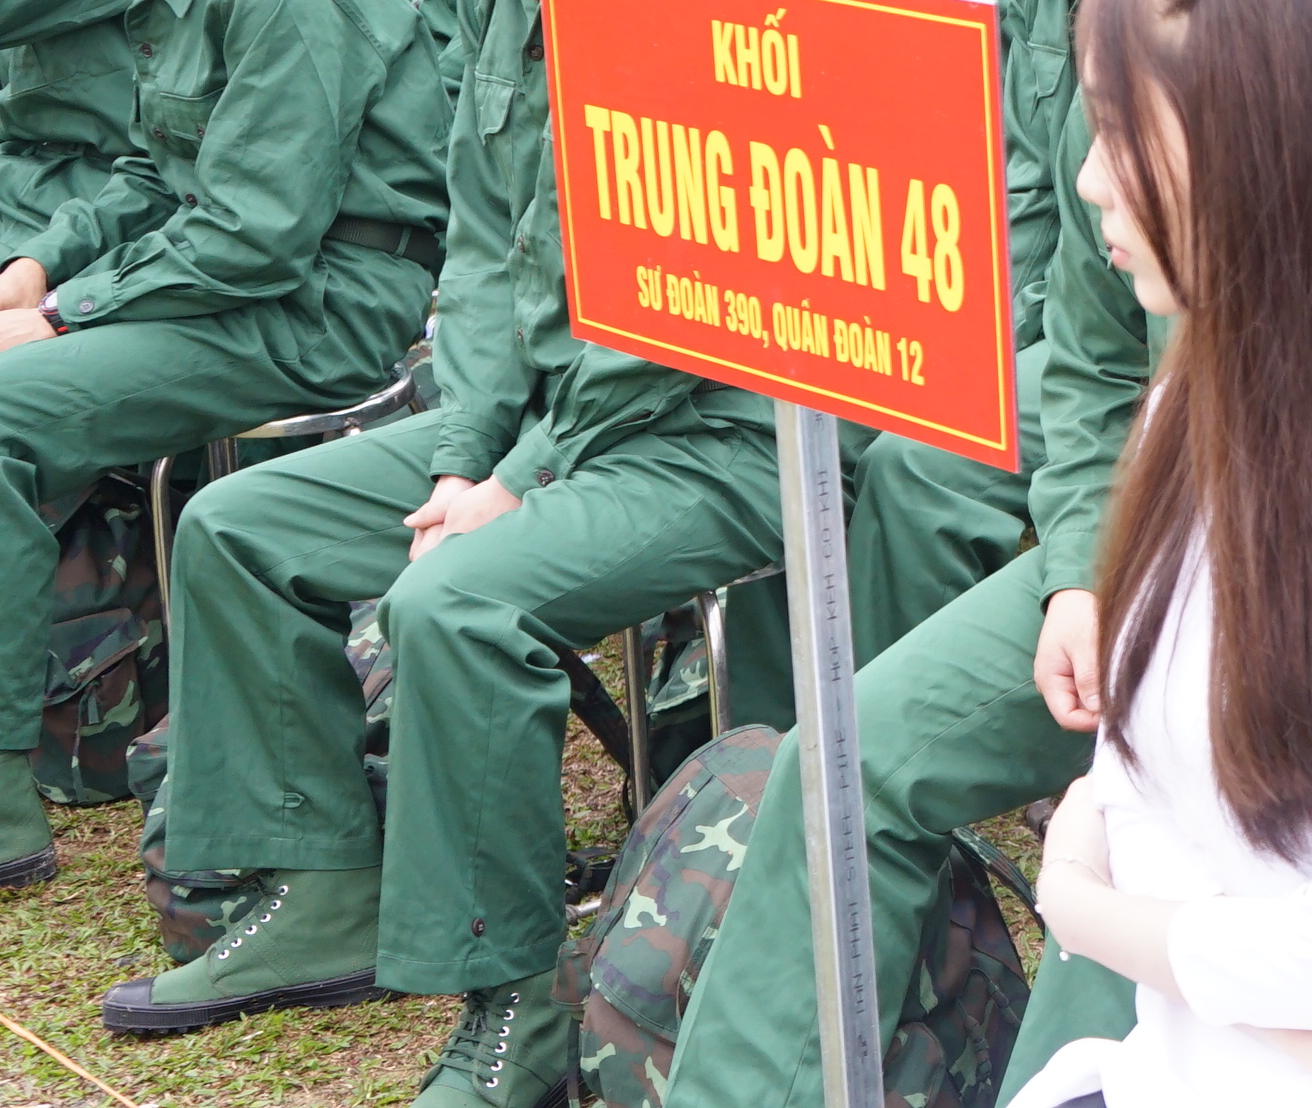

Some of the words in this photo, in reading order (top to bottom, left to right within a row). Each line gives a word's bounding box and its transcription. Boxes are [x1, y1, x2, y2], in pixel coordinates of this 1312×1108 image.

[711, 7, 802, 99] KHỐI
[584, 104, 740, 253] TRUNG
[749, 124, 886, 291] ĐOÀN
[900, 178, 965, 312] 48
[636, 265, 663, 311] SƯ
[665, 270, 721, 327] ĐOÀN
[723, 289, 770, 349] 390,
[772, 299, 830, 358] QUÂN
[833, 315, 893, 376] ĐOÀN
[896, 337, 925, 386] 12
